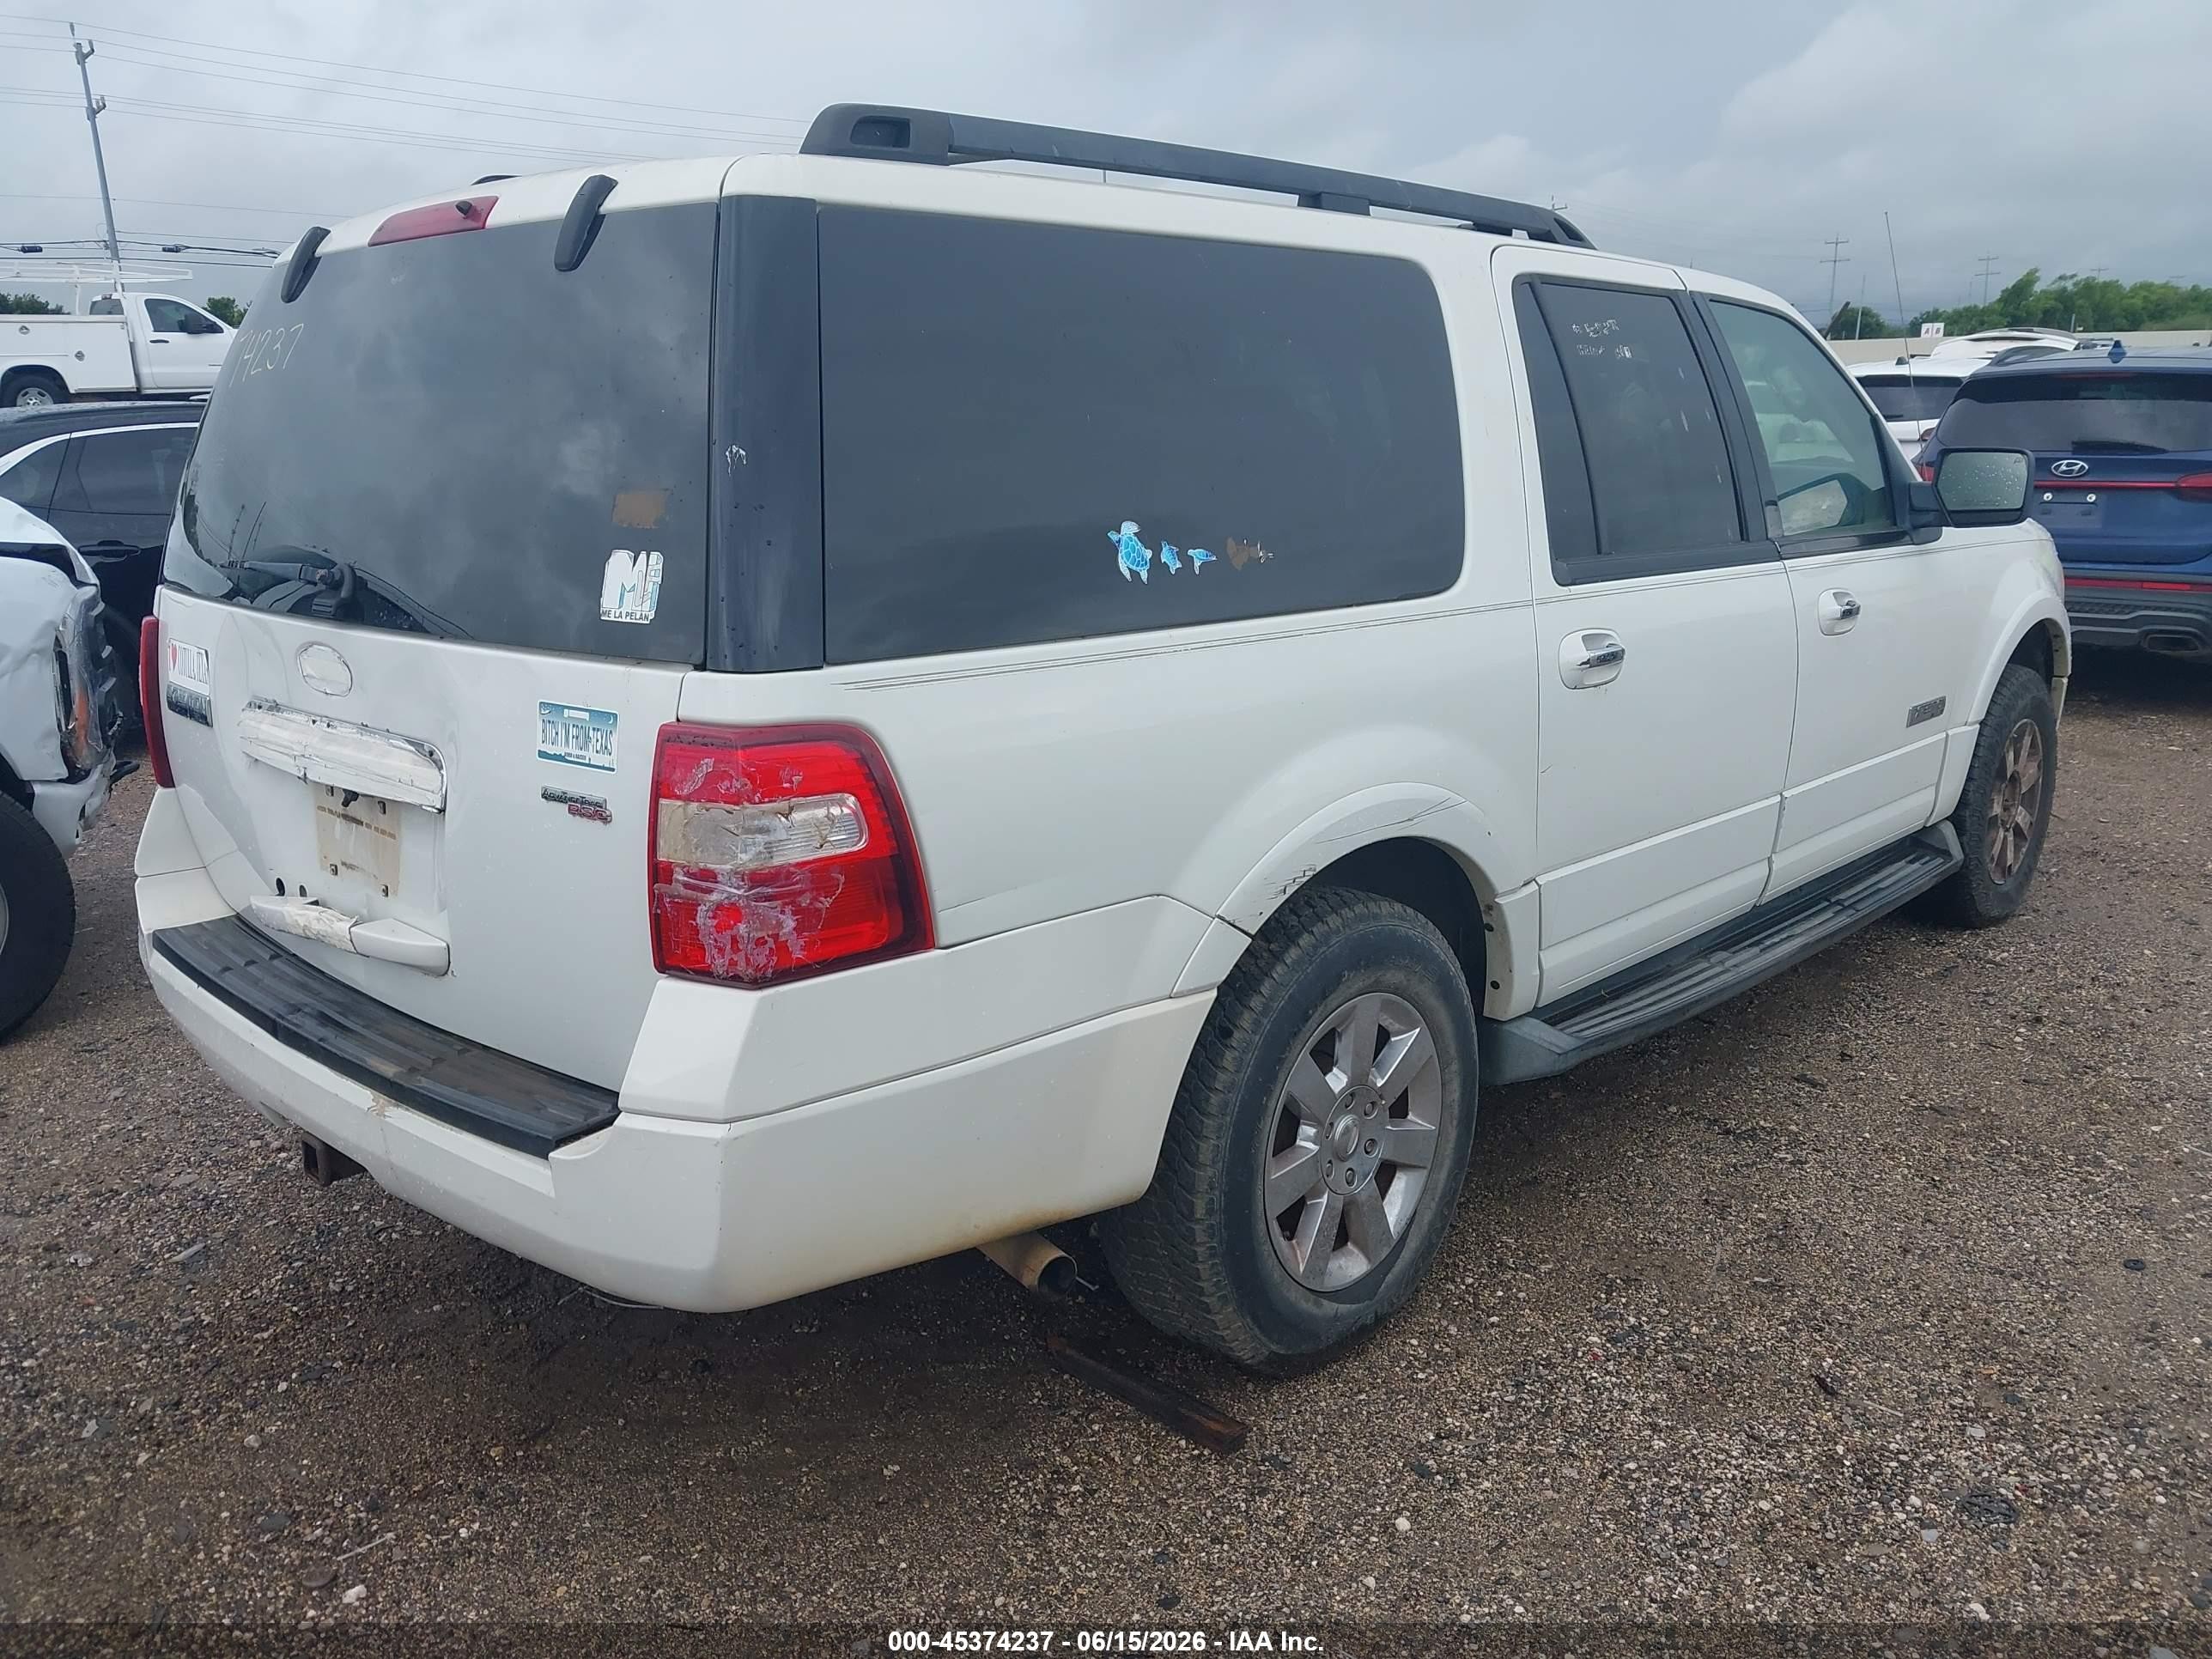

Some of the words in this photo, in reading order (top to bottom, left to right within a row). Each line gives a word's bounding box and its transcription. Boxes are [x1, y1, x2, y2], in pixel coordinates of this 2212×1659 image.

[613, 610, 623, 618] LA
[624, 611, 650, 622] PELAN
[541, 718, 560, 747] BITCH
[560, 721, 571, 750] I'M
[571, 723, 591, 753] FROM
[592, 726, 613, 757] TEXAS
